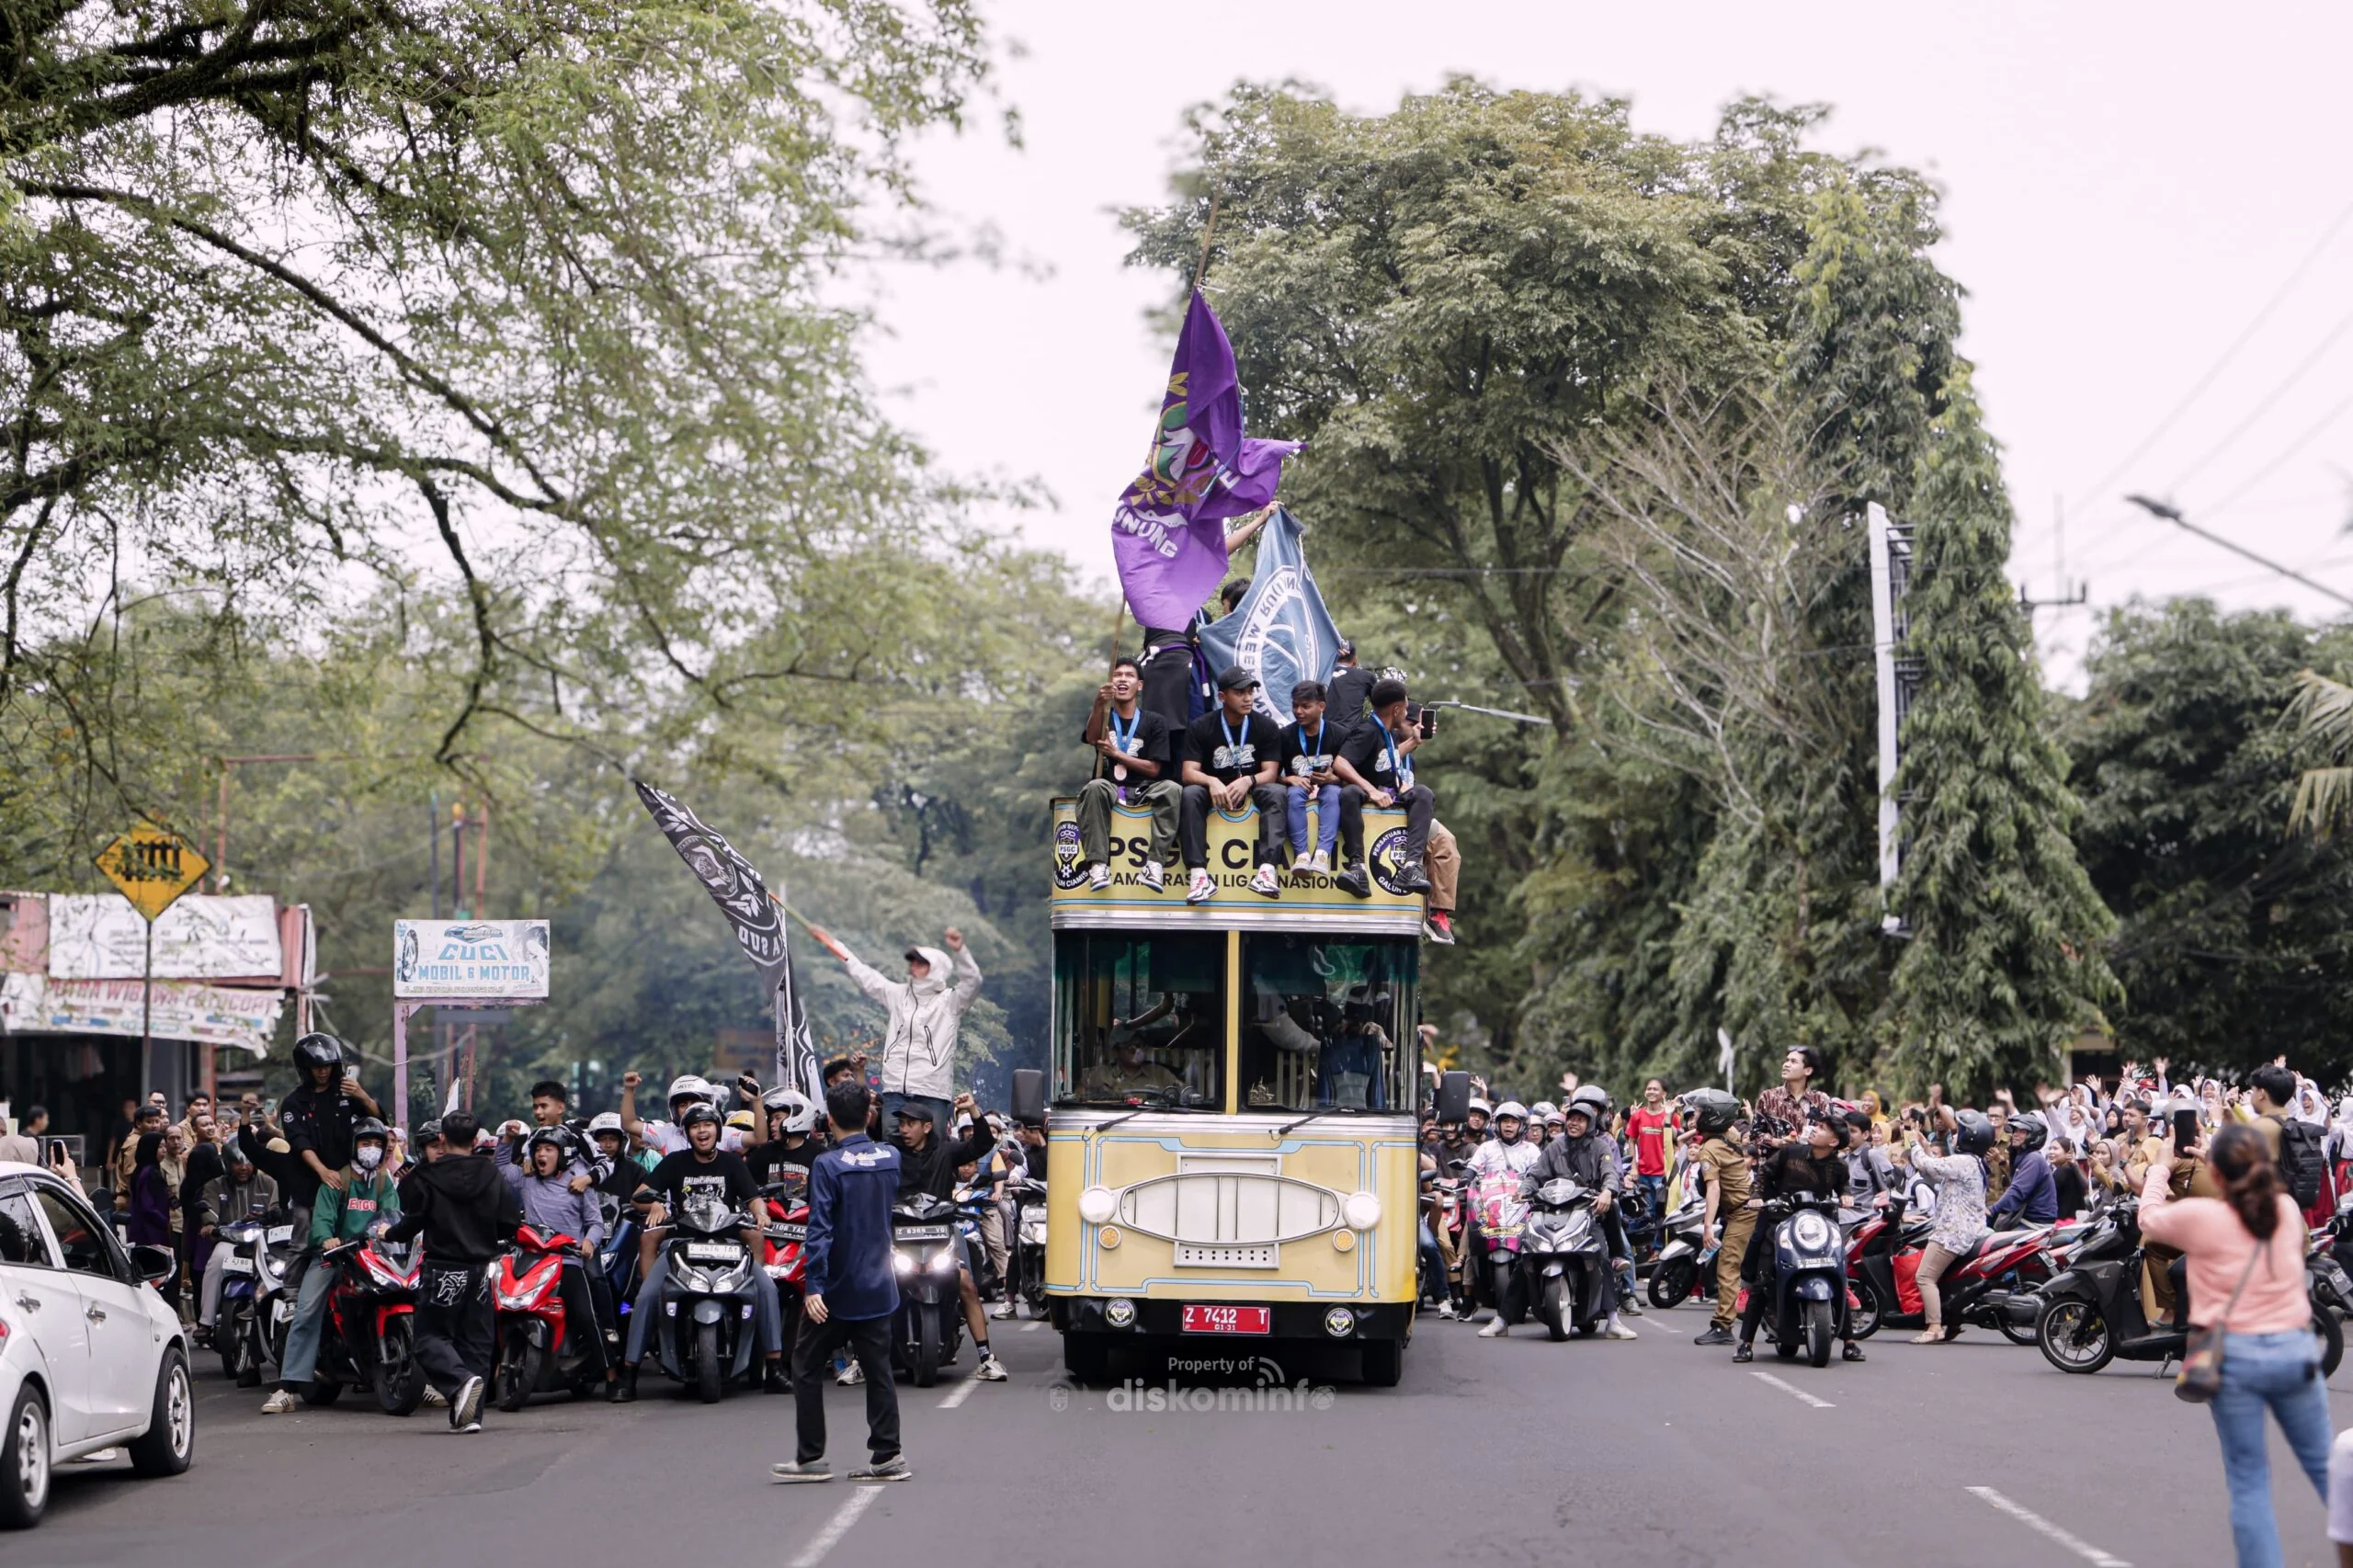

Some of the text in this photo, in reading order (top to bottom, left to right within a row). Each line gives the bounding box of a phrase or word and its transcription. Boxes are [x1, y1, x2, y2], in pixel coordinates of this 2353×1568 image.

[438, 944, 508, 960] CUCI
[418, 966, 462, 981] MOBIL
[480, 966, 530, 981] MOTOR
[1185, 1308, 1267, 1324] Z 7412 T
